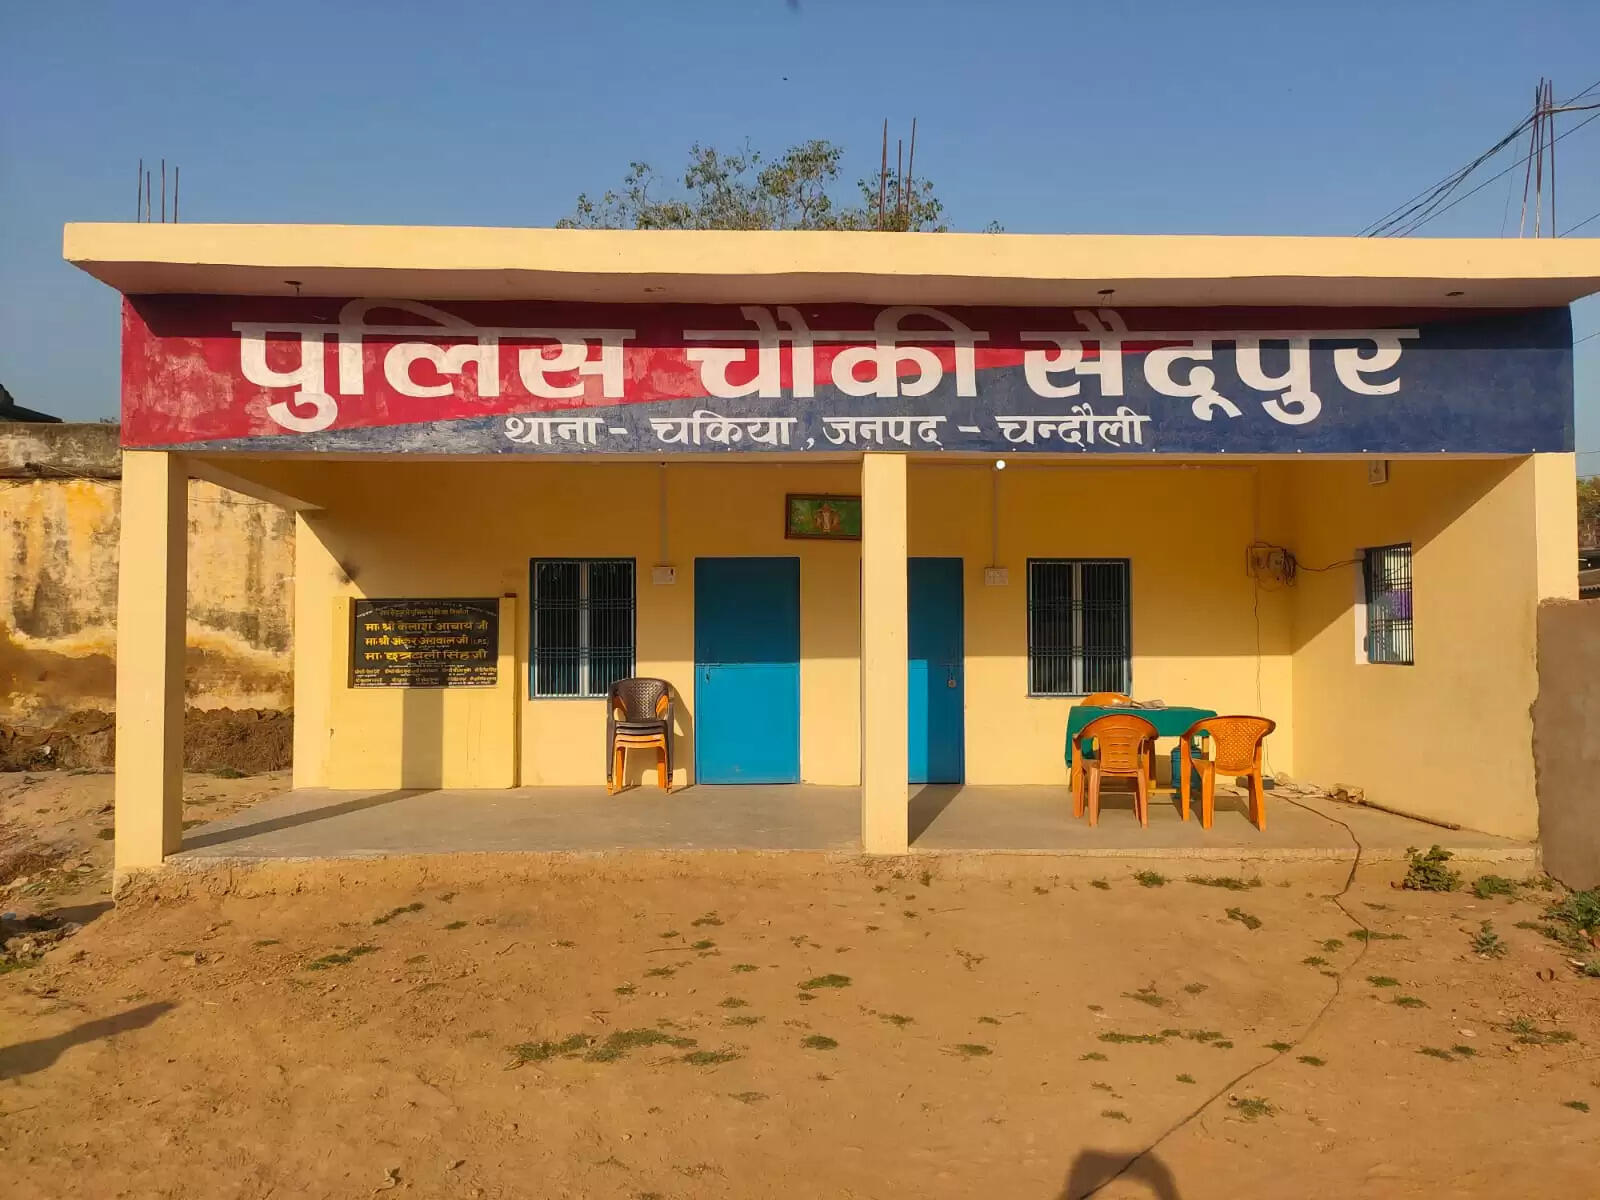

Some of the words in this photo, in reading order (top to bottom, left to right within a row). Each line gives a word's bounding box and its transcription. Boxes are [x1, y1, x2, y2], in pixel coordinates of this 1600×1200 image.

[231, 299, 636, 432] पुलिस
[683, 305, 990, 398] चौकी
[1020, 309, 1420, 425] सैदूपुर
[822, 416, 948, 448] जनपद
[995, 404, 1152, 448] चन्दौली
